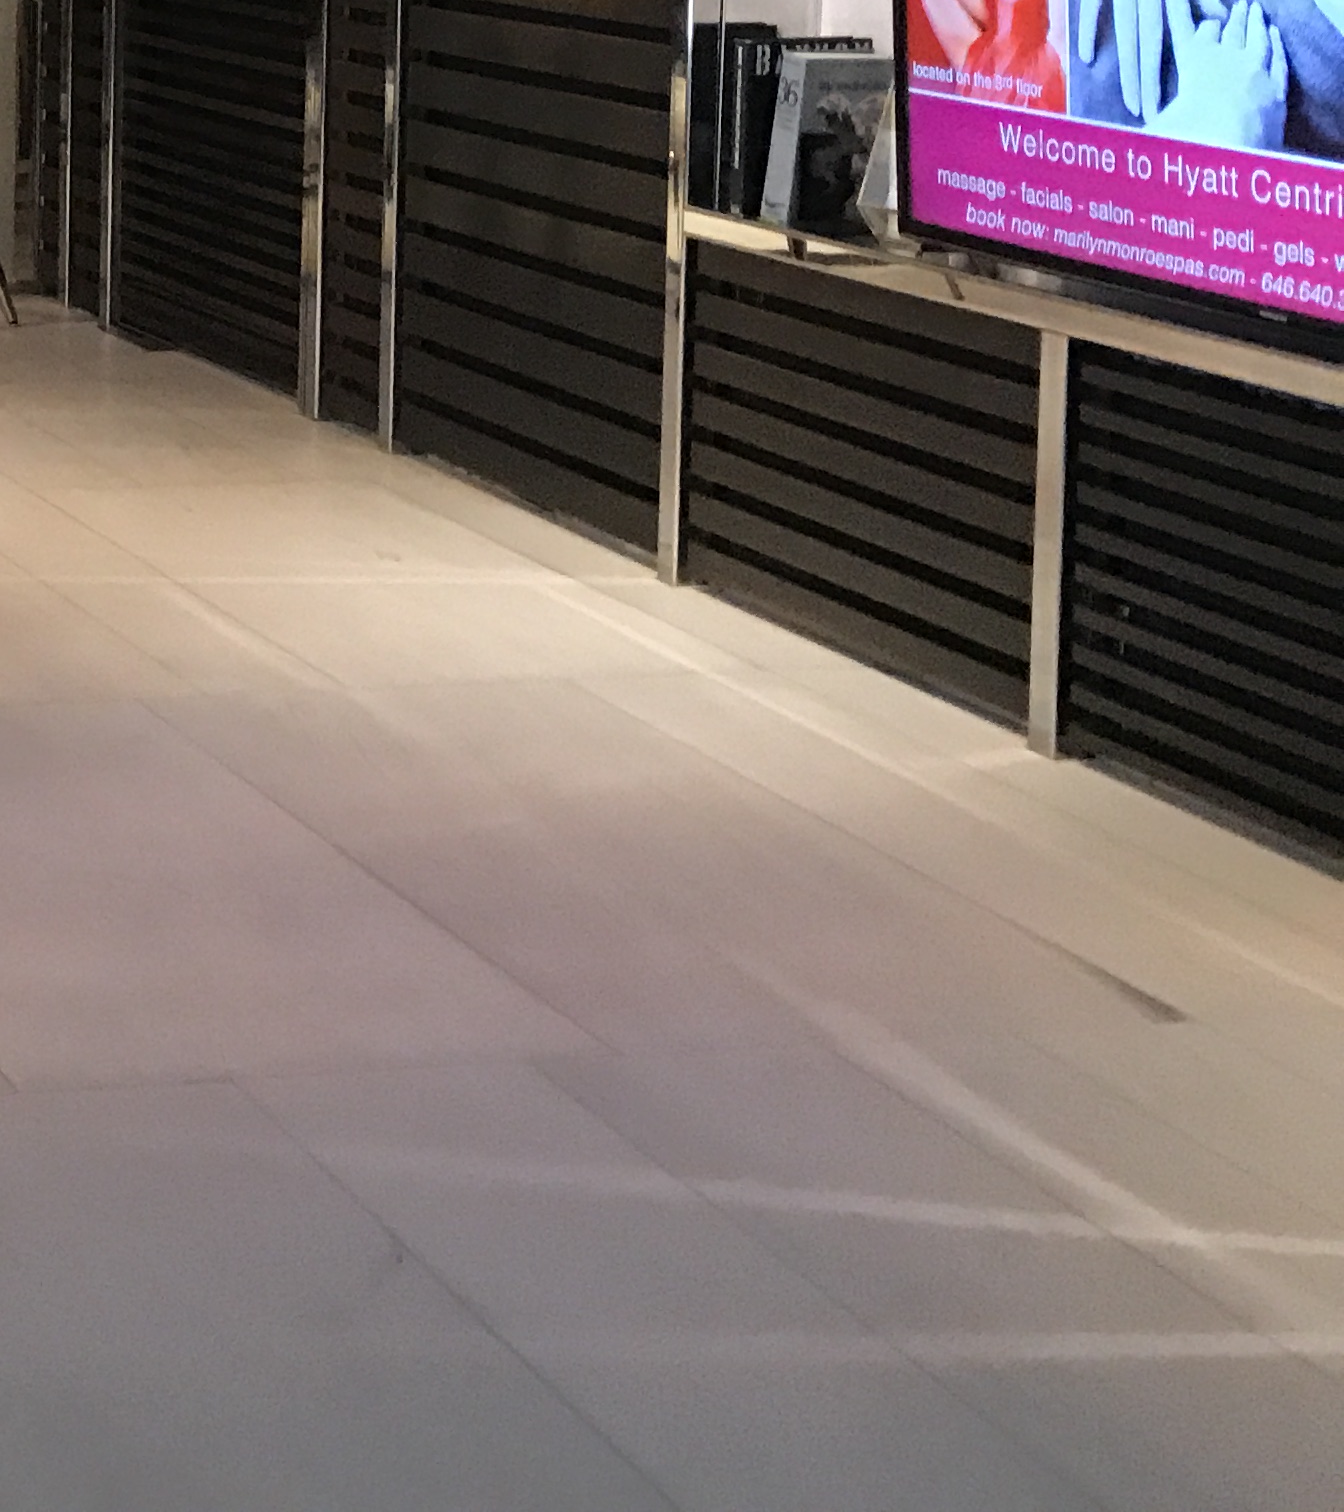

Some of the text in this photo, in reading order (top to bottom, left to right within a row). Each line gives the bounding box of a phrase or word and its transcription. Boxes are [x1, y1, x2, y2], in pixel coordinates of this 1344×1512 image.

[912, 59, 953, 84] located
[955, 70, 970, 86] on
[973, 71, 992, 88] the
[998, 121, 1344, 219] Welcome to Hyatt Centri
[937, 166, 1315, 269] massage facials salon mani pedi gels
[966, 202, 1246, 287] book now: marilynmonroespas.com
